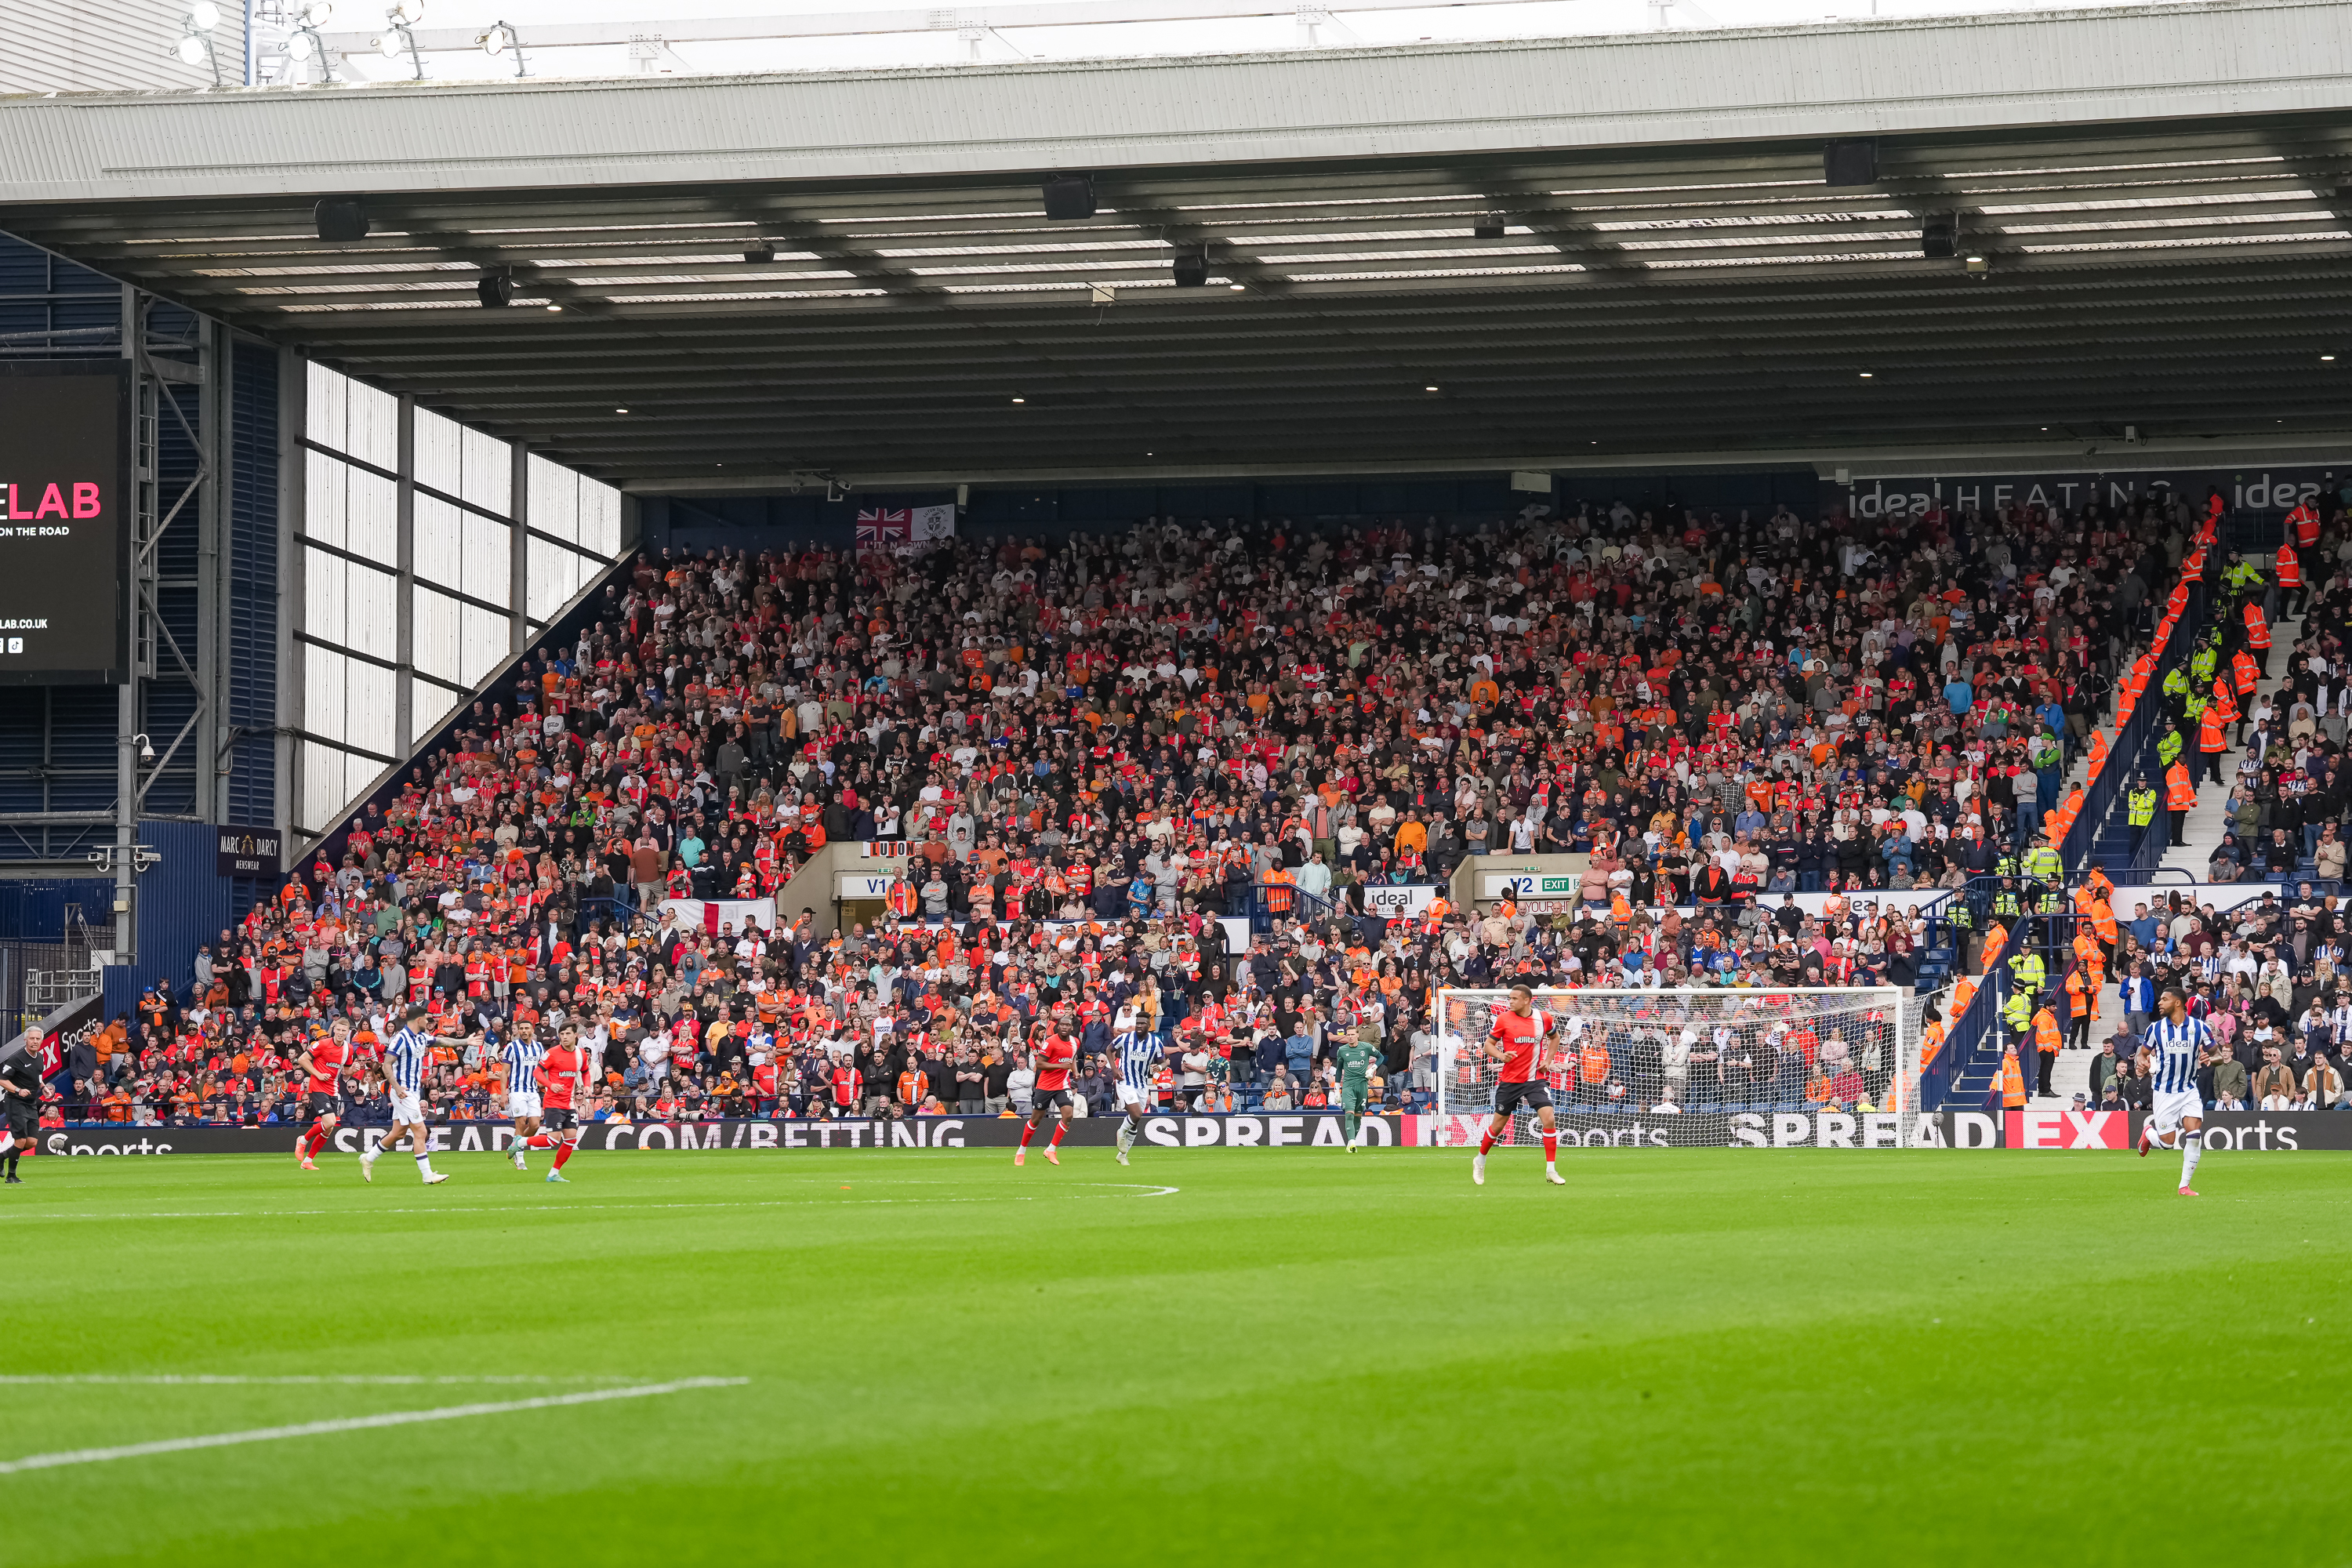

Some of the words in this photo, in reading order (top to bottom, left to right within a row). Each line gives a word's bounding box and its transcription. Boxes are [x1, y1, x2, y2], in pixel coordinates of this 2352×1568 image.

[2235, 473, 2332, 509] idea
[1849, 481, 1941, 518] ideal
[16, 527, 37, 536] THE
[39, 526, 70, 536] ROAD
[864, 541, 898, 550] LUTN
[220, 835, 240, 854] MARC
[256, 837, 278, 857] DARCY
[872, 842, 916, 857] LUTON
[235, 859, 260, 871] MENSWEAR
[867, 878, 886, 894] V1
[1510, 877, 1534, 893] V2
[1544, 879, 1567, 890] EXIT
[1372, 889, 1413, 906] ideal
[2165, 1039, 2191, 1047] ideal
[1130, 1050, 1149, 1058] ideal
[1145, 1116, 1392, 1147] SPREAD
[1730, 1112, 1996, 1149] SPREAD
[2023, 1111, 2112, 1149] EX
[2143, 1114, 2298, 1150] ports
